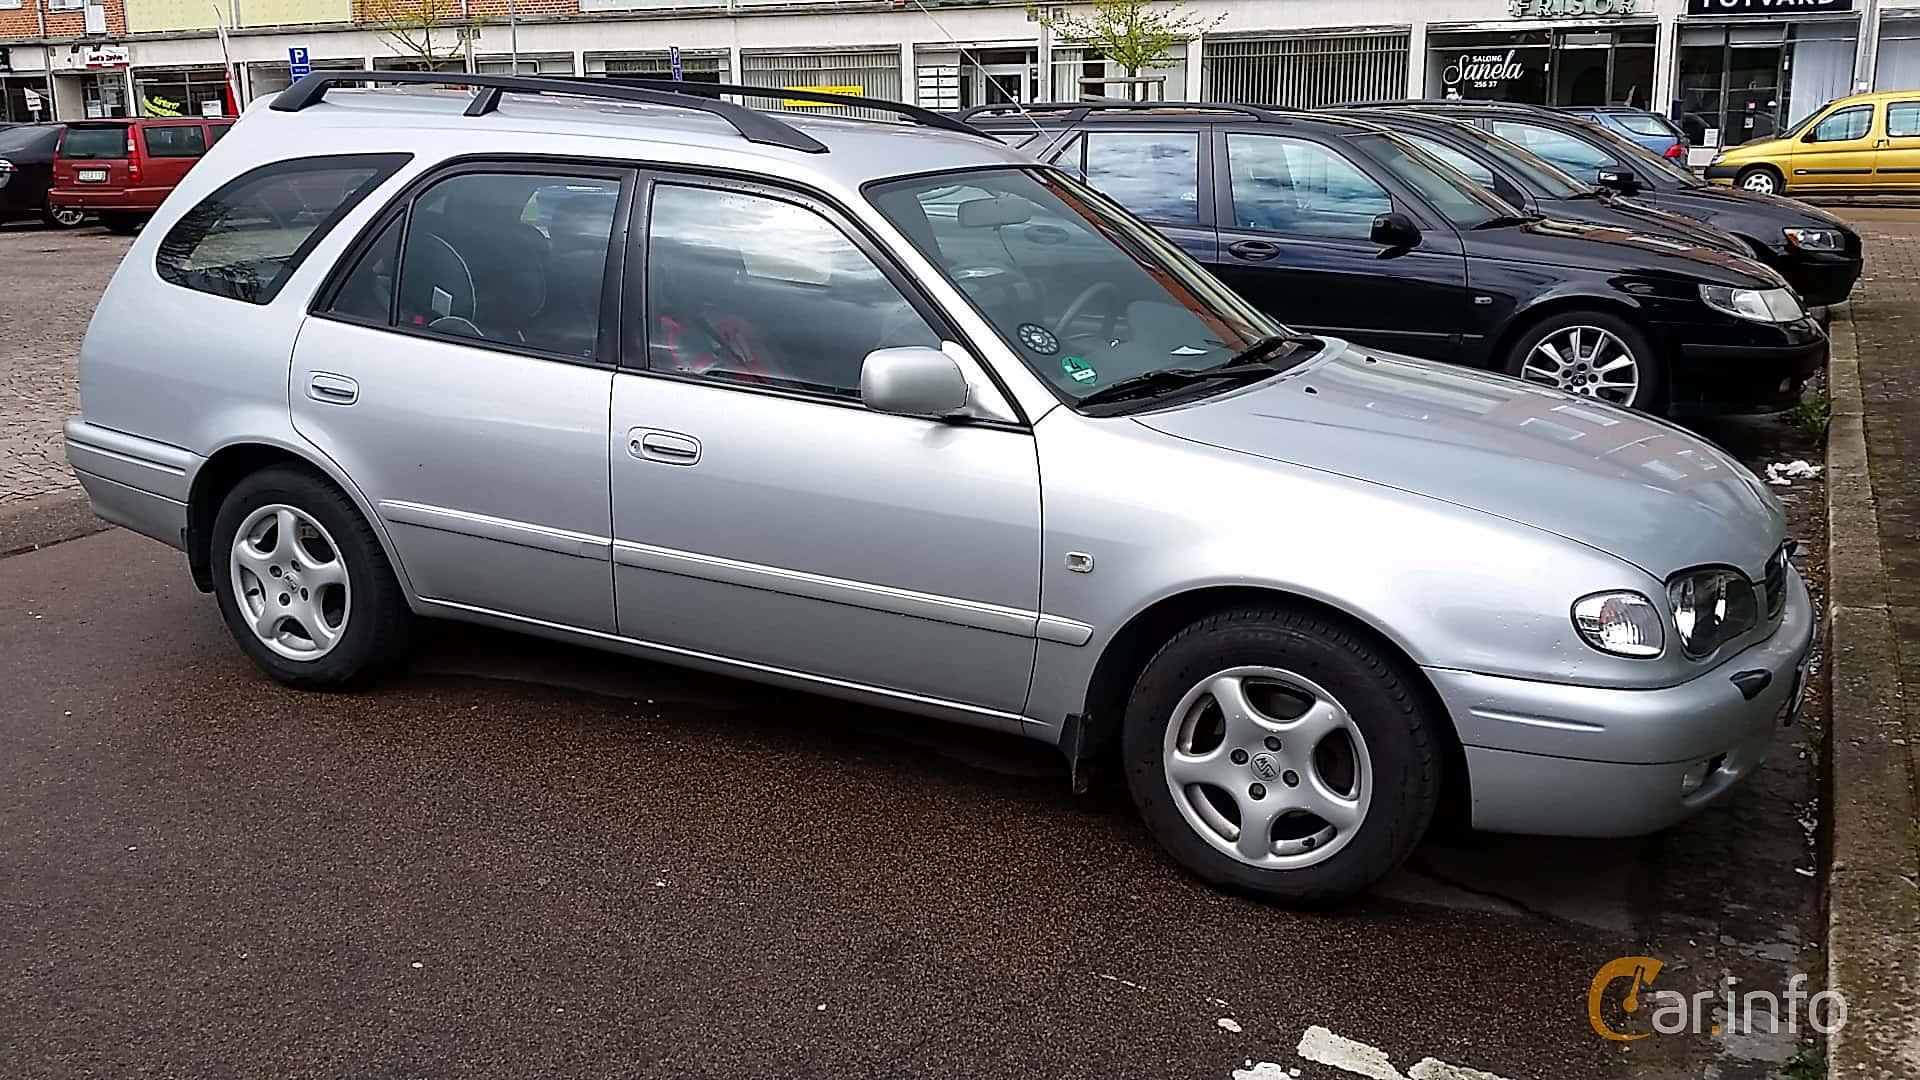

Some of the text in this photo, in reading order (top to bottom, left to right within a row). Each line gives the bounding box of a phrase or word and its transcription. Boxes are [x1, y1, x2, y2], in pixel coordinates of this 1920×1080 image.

[294, 49, 305, 64] P
[672, 47, 678, 64] P
[1442, 49, 1525, 85] Sanela
